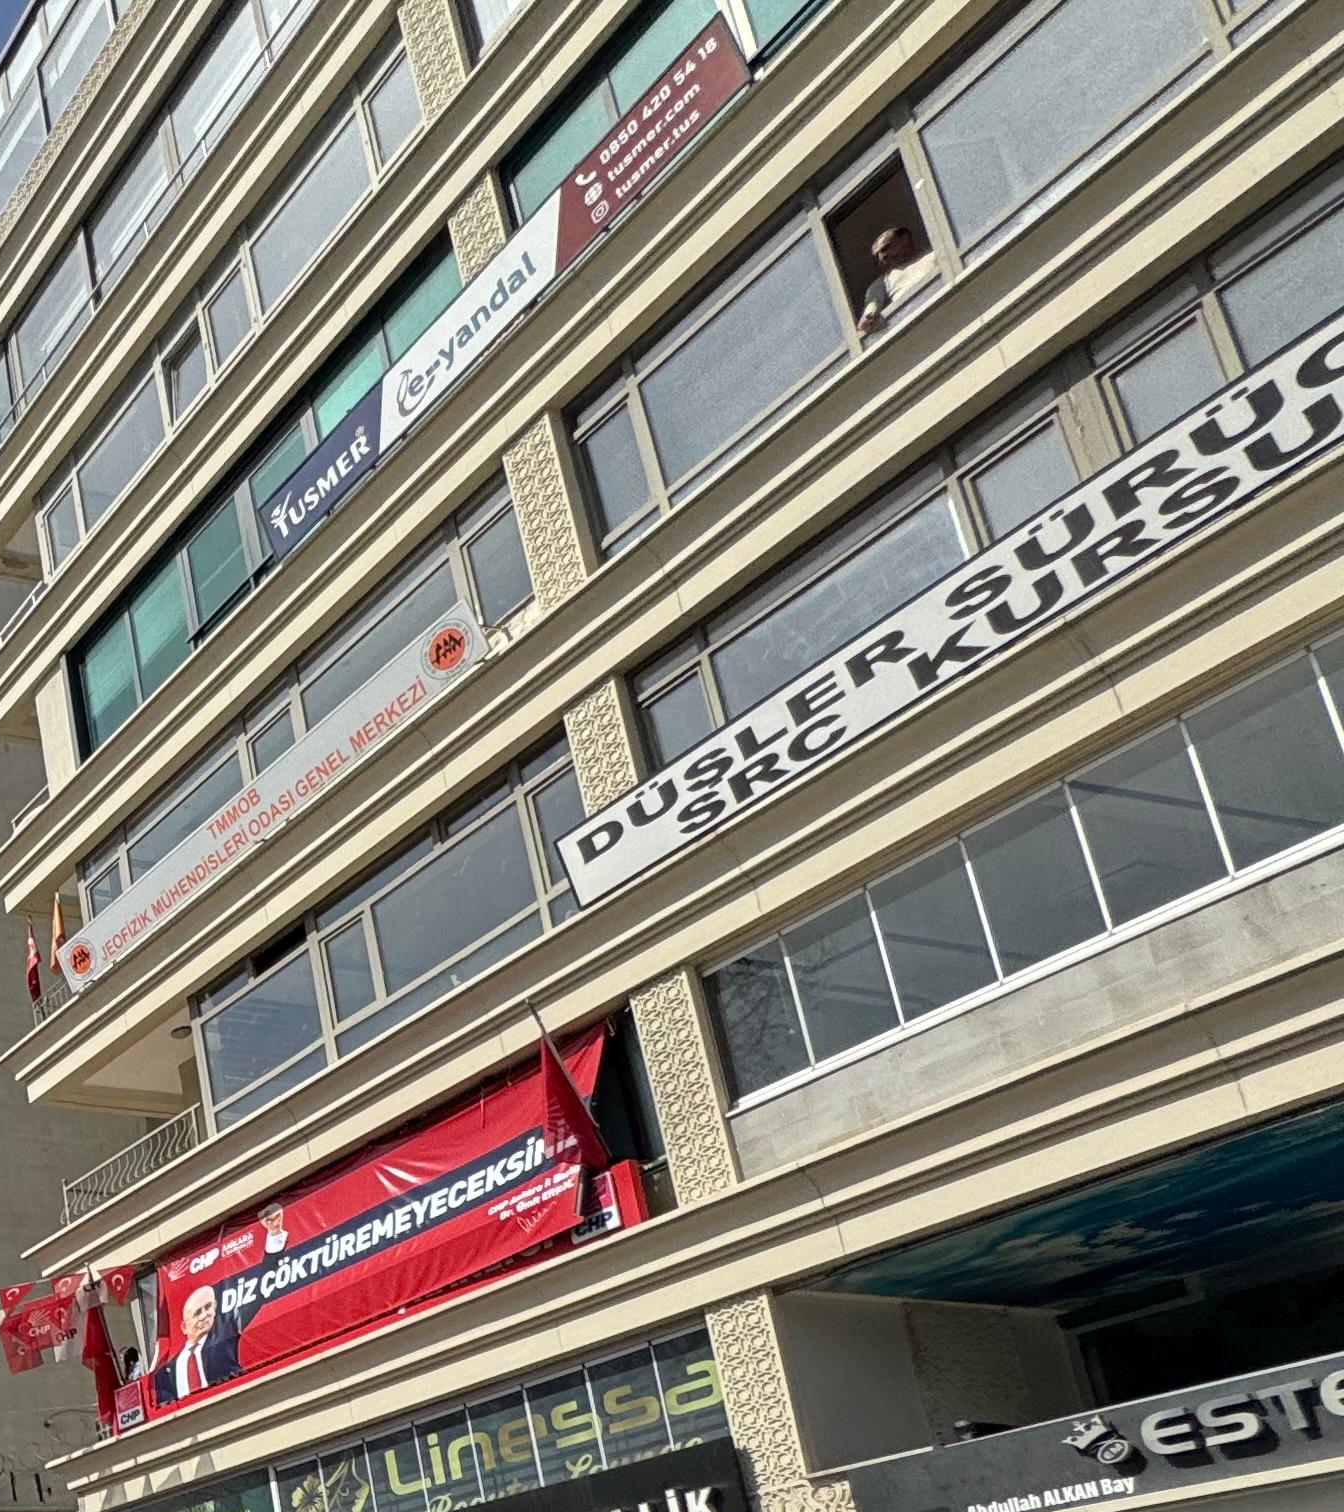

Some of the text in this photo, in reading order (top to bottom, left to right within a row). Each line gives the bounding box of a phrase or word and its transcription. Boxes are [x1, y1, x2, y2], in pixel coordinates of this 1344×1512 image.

[600, 120, 638, 164] 0850
[642, 85, 671, 121] 420
[673, 60, 697, 86] 54
[607, 84, 700, 181] tusmer.com
[615, 110, 700, 198] tusmer.tus
[270, 434, 371, 538] TUSMER
[907, 393, 1343, 691] KURSU
[102, 911, 151, 961] JEOFİZİK
[248, 791, 296, 837] ODASI
[295, 748, 351, 798] GENEL
[349, 675, 428, 753] MERKEZİ
[207, 788, 261, 840] TMMOB
[677, 714, 848, 834] SRC
[190, 1248, 219, 1274] CHP
[574, 1210, 613, 1237] CHP
[29, 1325, 50, 1336] CHP
[221, 1277, 258, 1314] DİZ
[120, 1409, 140, 1425] CHP
[385, 1359, 724, 1495] Linessa
[1043, 1480, 1099, 1509] ALKAN
[1100, 1475, 1136, 1496] Bay
